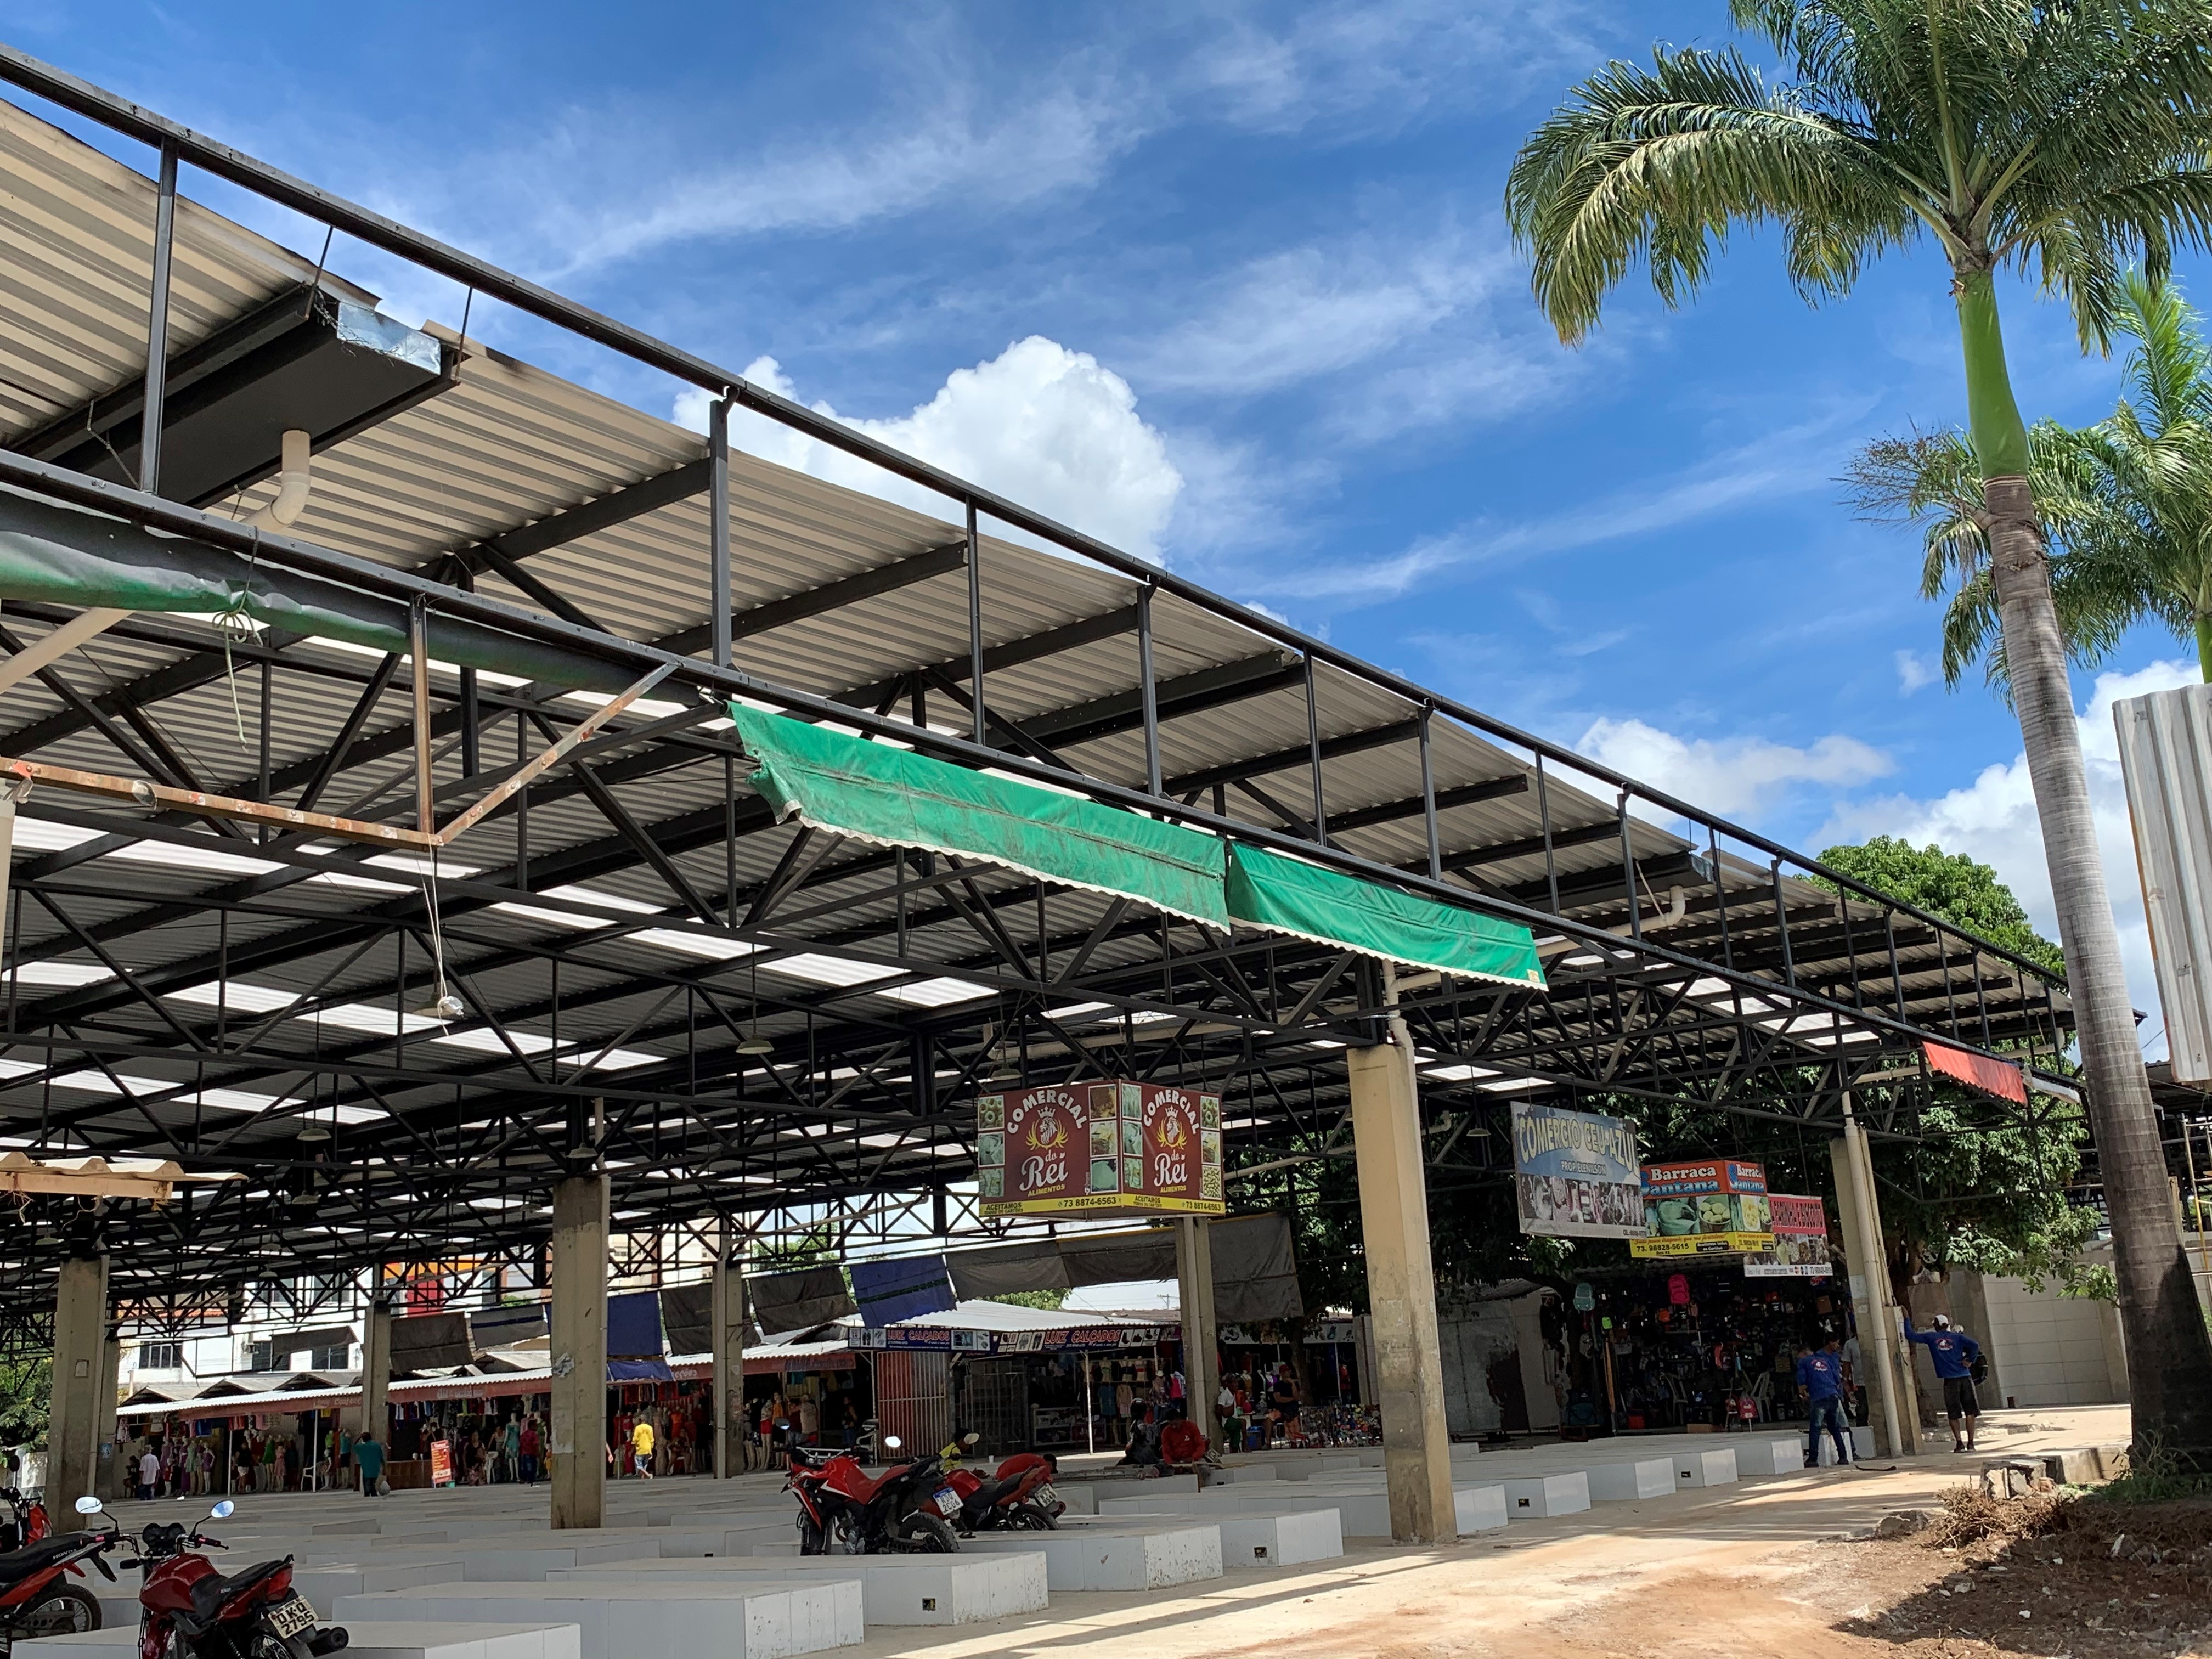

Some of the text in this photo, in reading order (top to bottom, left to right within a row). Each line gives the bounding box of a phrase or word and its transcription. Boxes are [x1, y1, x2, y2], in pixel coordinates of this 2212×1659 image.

[1007, 1089, 1087, 1133] COMERCIAL
[1143, 1089, 1200, 1135] COMERCIAL
[1519, 1116, 1581, 1164] COMERCIO
[1045, 1149, 1058, 1162] do
[1171, 1149, 1180, 1161] do
[1019, 1152, 1068, 1191] Rei
[1154, 1153, 1188, 1187] Rei
[1650, 1167, 1717, 1181] Barraca
[1736, 1164, 1762, 1178] Barraca
[1728, 1164, 1764, 1192] Santana
[1028, 1184, 1065, 1197] ALIMENTOS
[1160, 1185, 1187, 1193] ALIMENTOS
[986, 1202, 1022, 1210] ACEITAMOS
[1075, 1197, 1116, 1206] 8874-6563
[1649, 1243, 1689, 1251] 98828-5615
[887, 1329, 950, 1342] LUIZ CALÇADOS
[1044, 1329, 1121, 1346] LUIZ CALÇADOS
[281, 1611, 314, 1635] 2795
